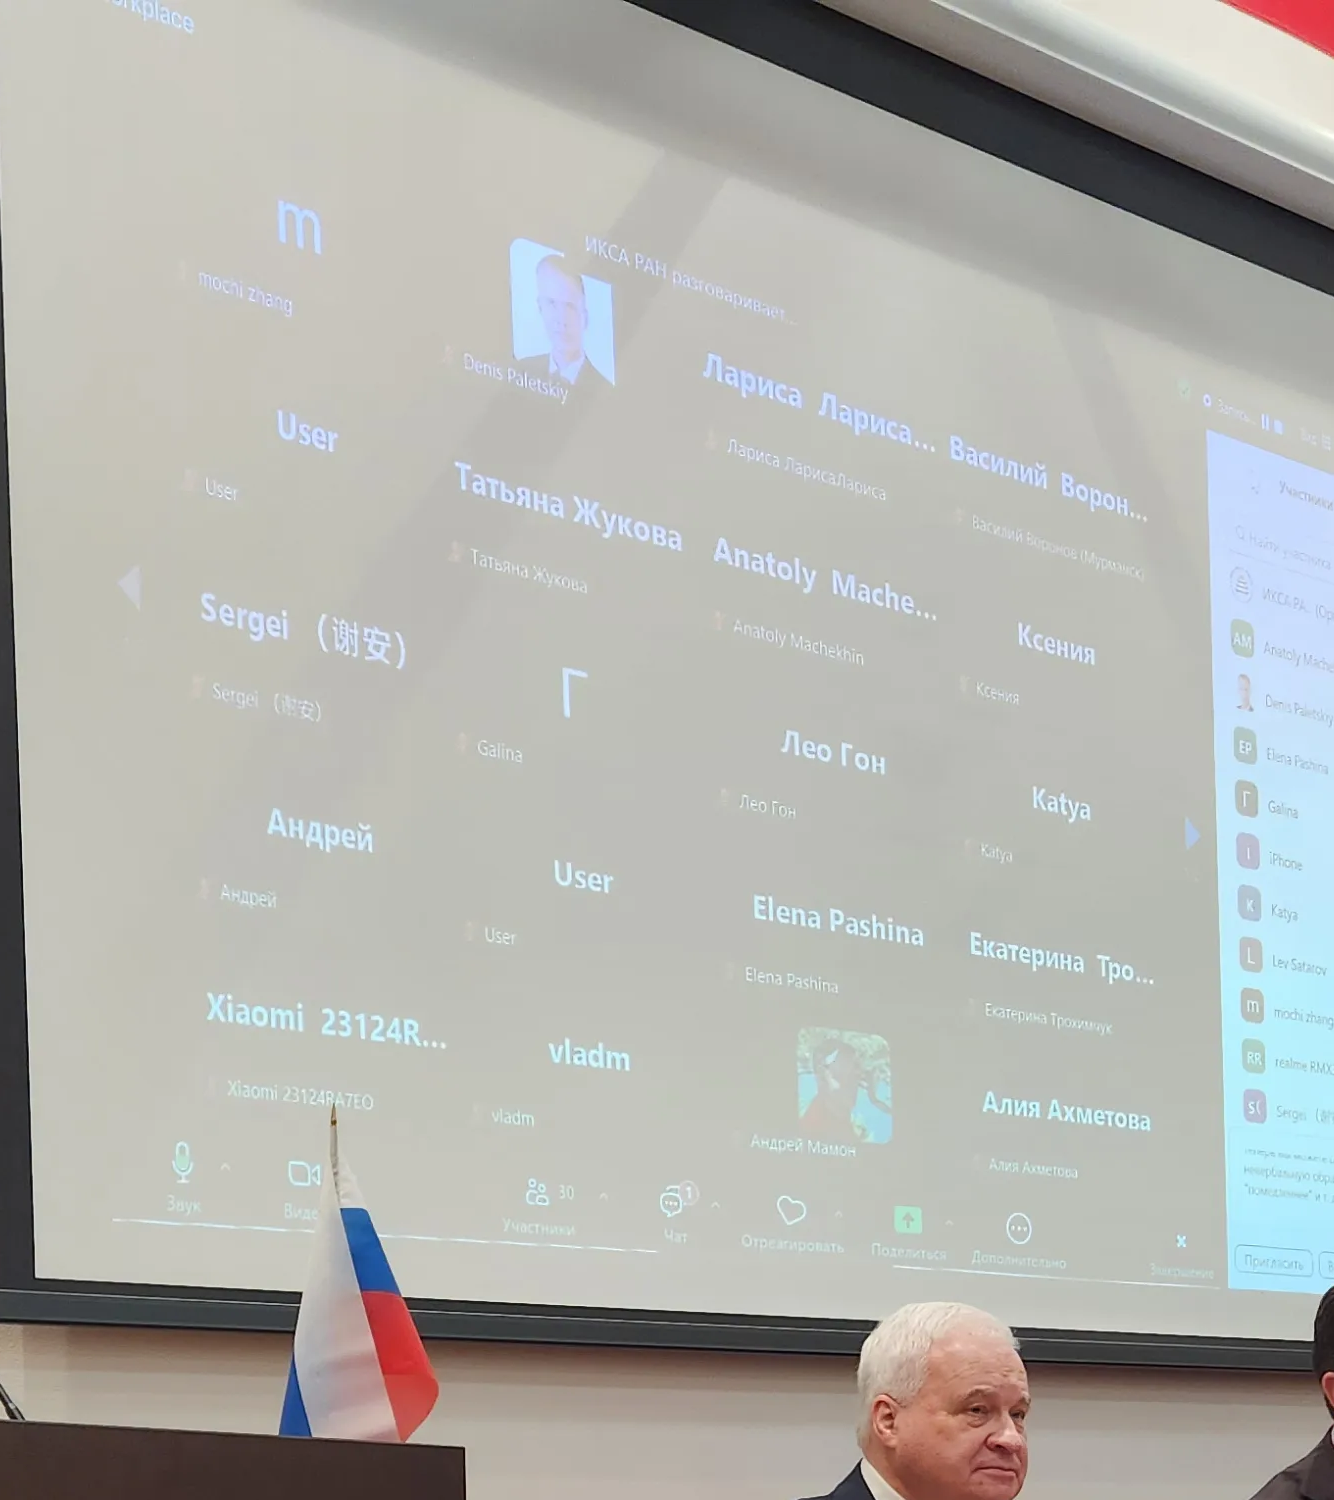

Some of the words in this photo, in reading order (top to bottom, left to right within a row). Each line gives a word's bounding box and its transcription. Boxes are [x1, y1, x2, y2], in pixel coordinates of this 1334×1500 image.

[111, 0, 195, 33] kplace
[585, 235, 631, 267] ИКСА
[634, 252, 667, 280] РАН
[198, 270, 244, 300] mochi
[247, 284, 294, 317] zhang
[462, 351, 504, 382] Denis
[507, 370, 569, 405] Paletskiy
[703, 351, 804, 410] Лариса
[818, 391, 937, 453] Лариса...
[276, 408, 340, 454] User
[726, 438, 780, 469] Лариса
[783, 455, 888, 502] ЛарисаЛариса
[948, 434, 1048, 491] Василий
[1060, 471, 1149, 523] Ворон...
[204, 476, 240, 502] User
[454, 461, 565, 519] Татьяна
[573, 495, 684, 553] Жукова
[971, 513, 1025, 546] Василий
[469, 547, 528, 580] Татьяна
[532, 563, 588, 595] Жукова
[713, 536, 818, 594] Anatoly
[831, 569, 938, 622] Mache...
[199, 592, 289, 642] Sergei
[732, 618, 787, 648] Anatoly
[790, 633, 865, 667] Machekhin
[1016, 620, 1096, 666] Ксения
[1232, 631, 1254, 651] AM
[1263, 640, 1302, 668] Anatoly
[211, 681, 260, 710] Sergei
[975, 680, 1020, 707] Ксения
[1265, 693, 1293, 714] Denis
[477, 738, 524, 764] Galina
[780, 728, 834, 764] Лео
[839, 740, 887, 776] Гон
[1266, 747, 1293, 767] Elena
[738, 792, 768, 814] Лео
[771, 799, 798, 821] Гон
[1031, 783, 1093, 824] Katya
[1267, 799, 1299, 820] Galina
[267, 806, 375, 854] Андрей
[979, 841, 1014, 865] Katya
[1267, 850, 1304, 872] iPhone
[552, 860, 615, 896] User
[219, 883, 278, 910] Андрей
[753, 893, 822, 932] Elena
[828, 907, 925, 948] Pashina
[1270, 903, 1299, 924] Katya
[484, 924, 518, 948] User
[968, 930, 1085, 974] Екатерина
[1095, 953, 1156, 986] Тро...
[1272, 954, 1290, 971] Lev
[744, 964, 783, 988] Elena
[786, 972, 840, 995] Pashina
[206, 992, 305, 1034] Xiaomi
[320, 1007, 449, 1050] 23124R...
[983, 1001, 1049, 1027] Екатерина
[1049, 1011, 1115, 1037] Трохимчук
[1273, 1005, 1304, 1023] mochi
[1304, 1010, 1334, 1030] zhang
[547, 1037, 631, 1072] vladm
[1275, 1056, 1308, 1073] realme
[227, 1079, 278, 1103] Xiaomi
[490, 1107, 535, 1129] vladm
[982, 1089, 1042, 1122] Алия
[1047, 1097, 1152, 1132] Ахметова
[750, 1133, 803, 1156] Андрей
[807, 1138, 857, 1160] Мамон
[988, 1157, 1020, 1176] Алия
[1021, 1161, 1079, 1181] Ахметова
[165, 1194, 202, 1214] Звук
[558, 1184, 575, 1201] 30
[284, 1201, 320, 1222] Виде
[501, 1217, 576, 1238] Участники
[664, 1228, 689, 1246] Чат
[741, 1232, 845, 1256] Отреагировать
[870, 1241, 948, 1264] Поделиться
[971, 1249, 1067, 1272] Дополнительно
